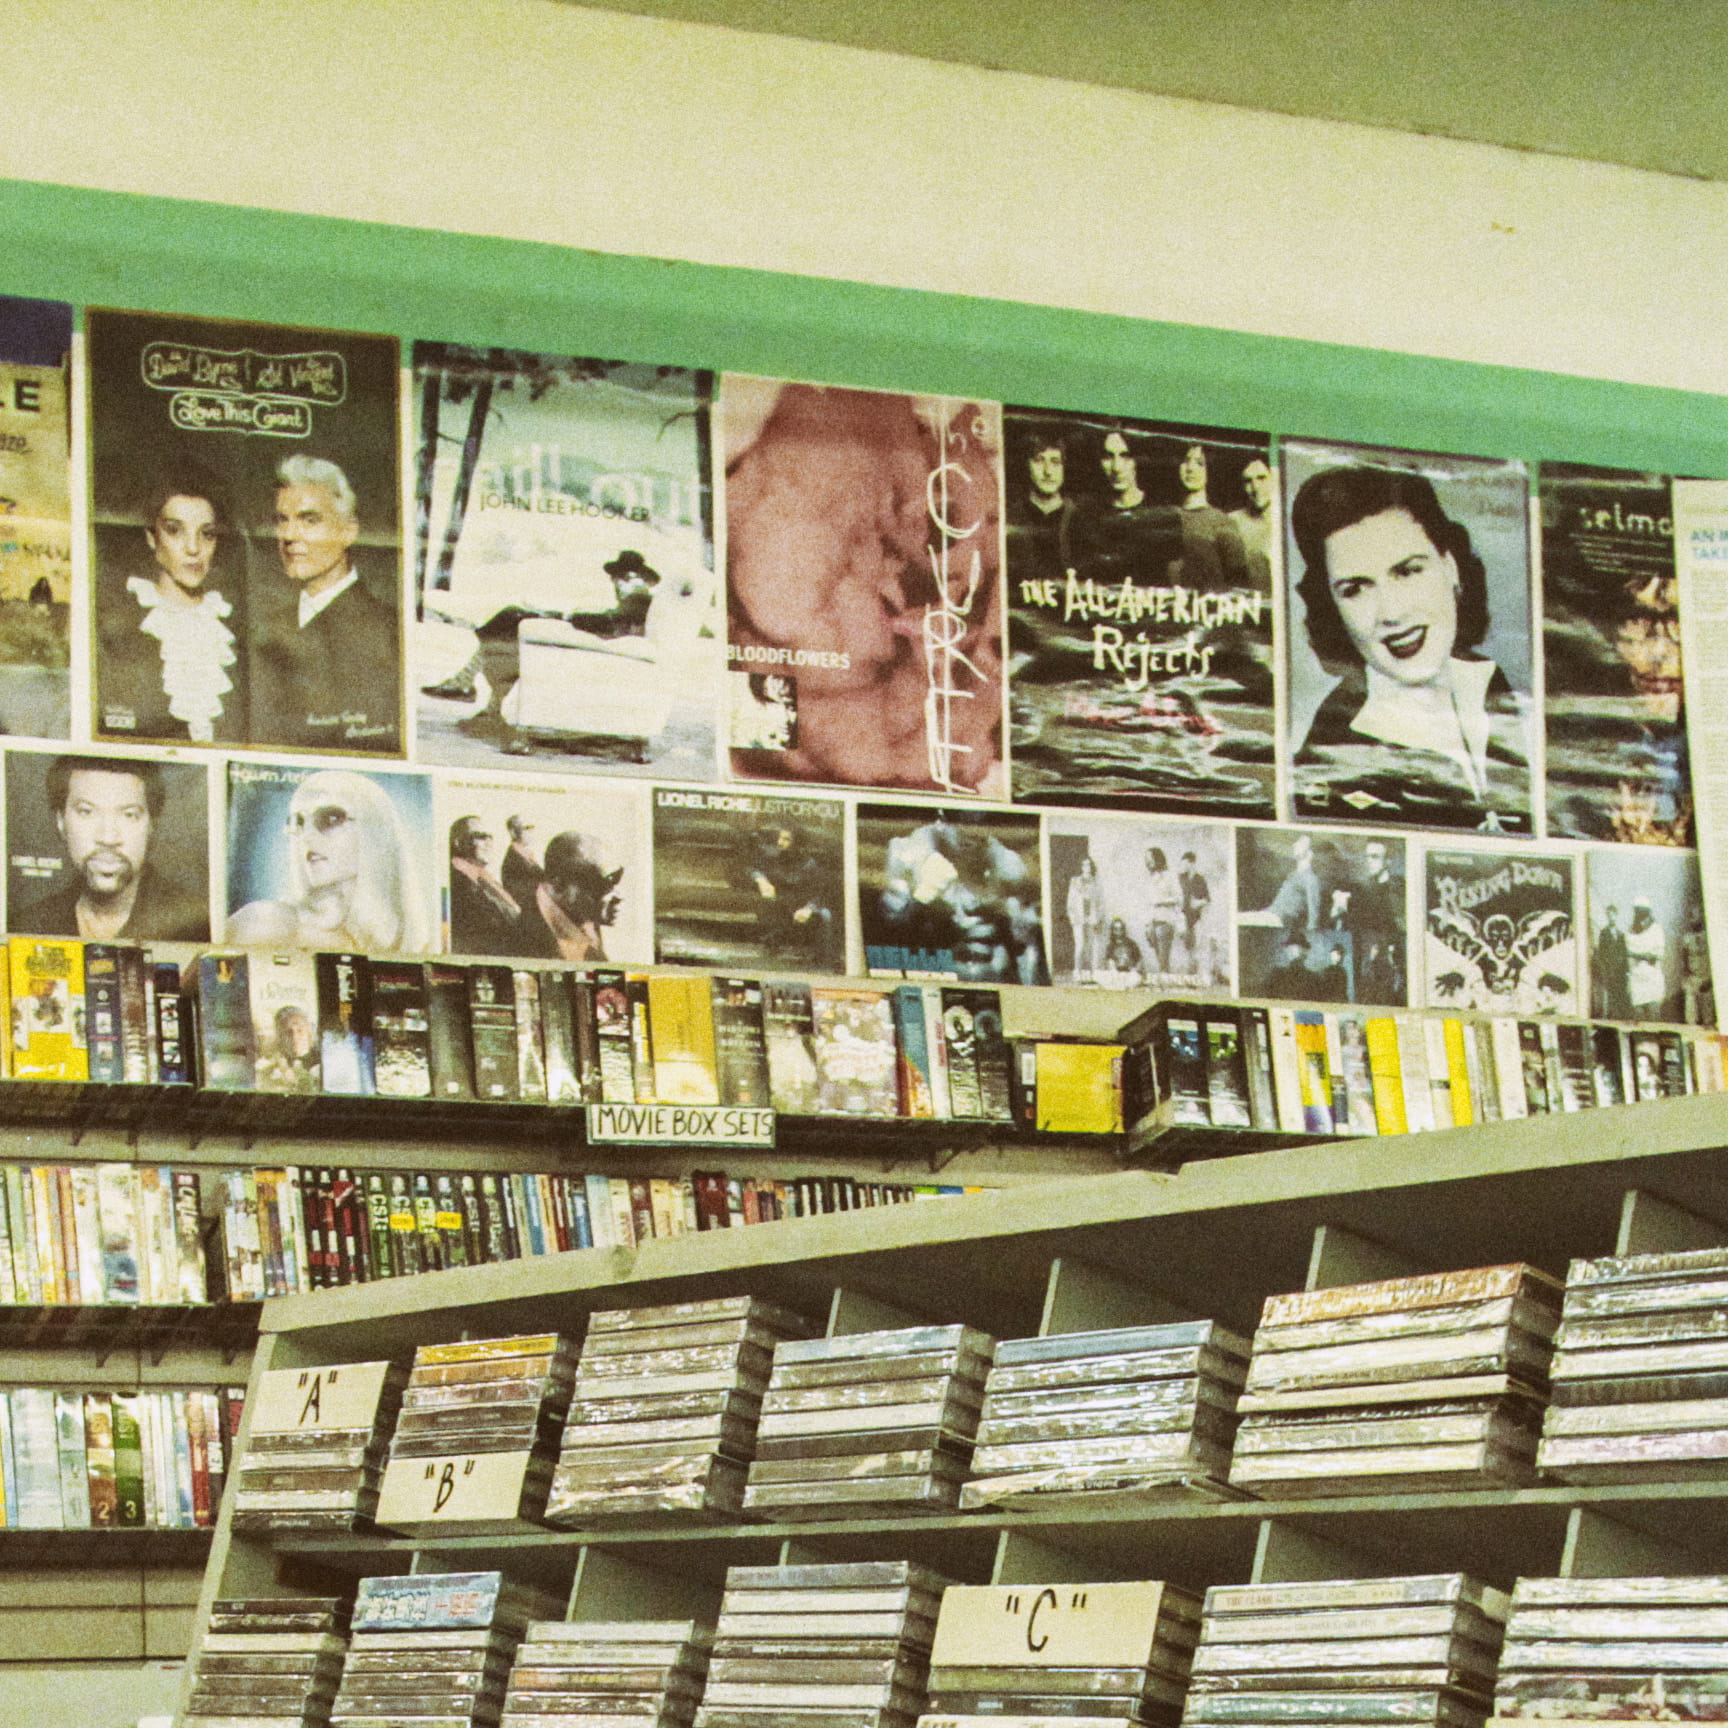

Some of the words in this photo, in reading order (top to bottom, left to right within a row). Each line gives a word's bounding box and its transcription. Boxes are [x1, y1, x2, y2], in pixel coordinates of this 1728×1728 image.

[480, 488, 533, 514] JOHN
[535, 493, 568, 516] LEE
[570, 497, 652, 523] HOOKER
[726, 644, 852, 671] BLOODFLOWERS
[596, 1106, 670, 1136] MOVIE
[672, 1108, 716, 1136] BOX
[724, 1110, 773, 1136] SETS
